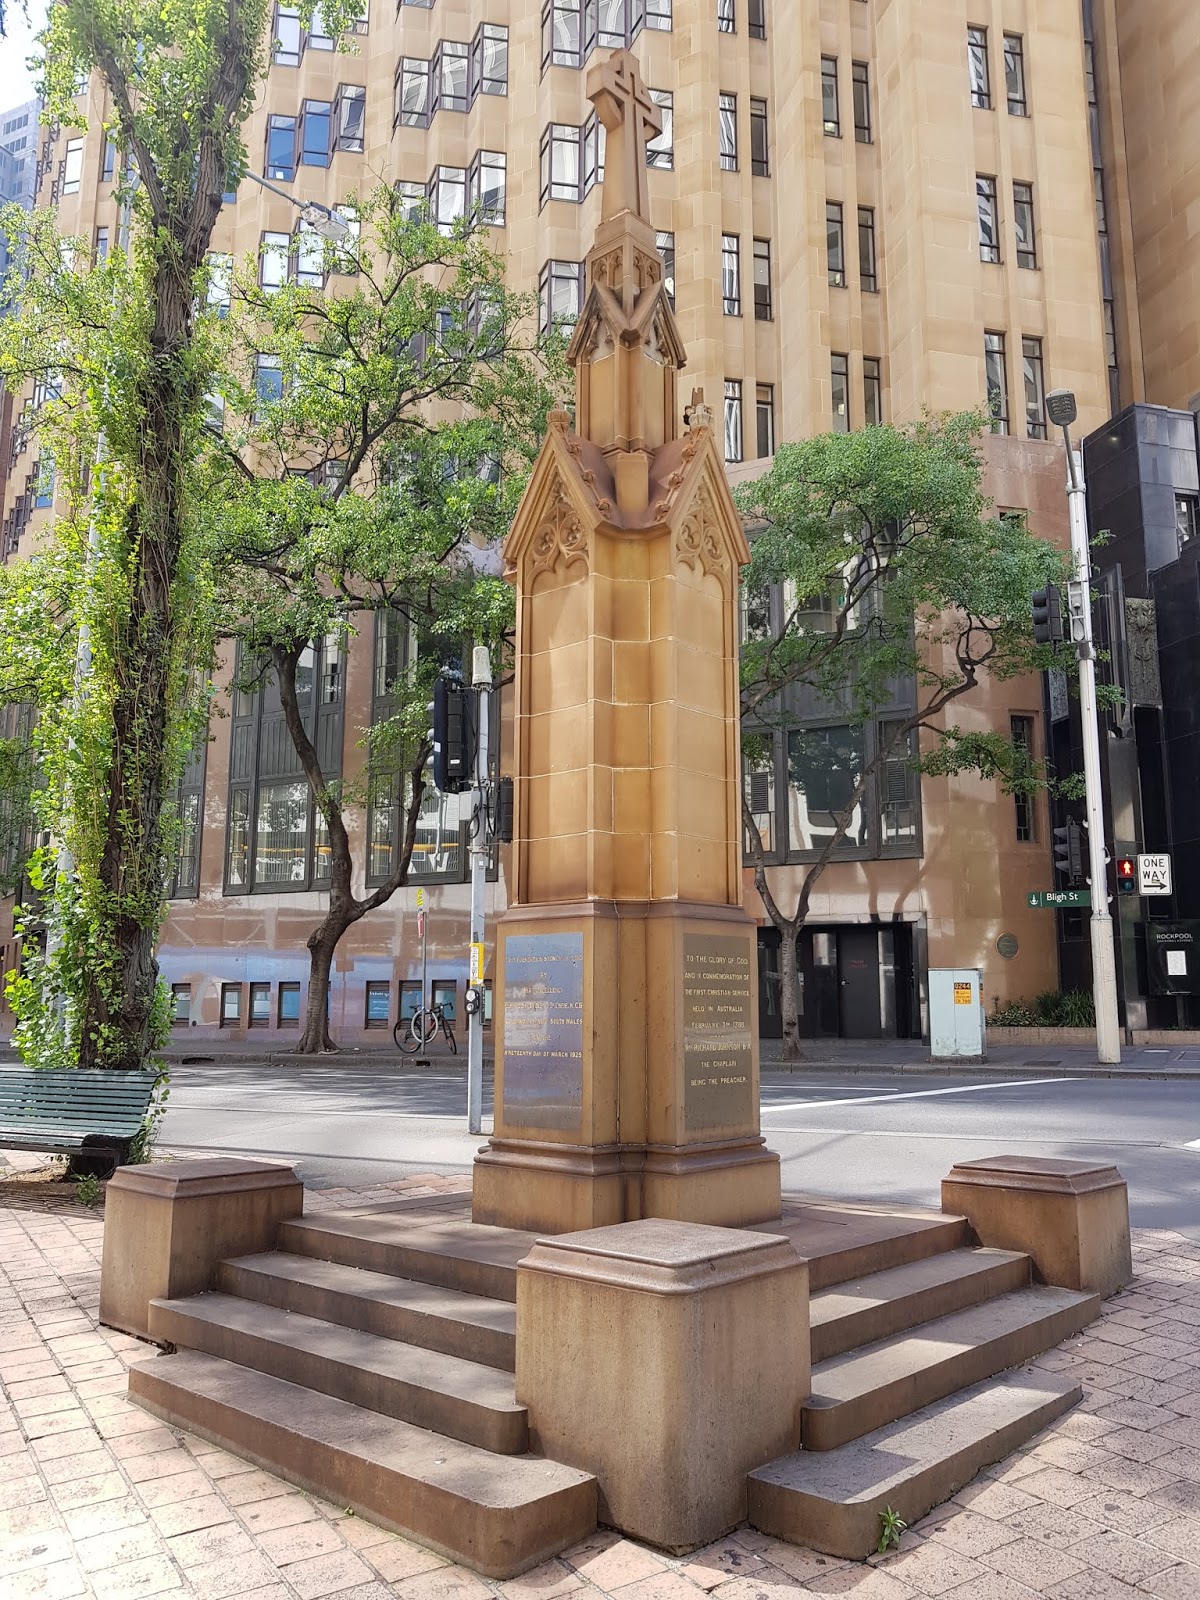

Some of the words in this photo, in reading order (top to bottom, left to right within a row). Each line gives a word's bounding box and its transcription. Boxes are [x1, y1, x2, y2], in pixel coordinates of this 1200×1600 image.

[1143, 858, 1165, 868] ONE
[1142, 870, 1167, 880] WAY
[1046, 892, 1067, 903] Bligh
[1068, 892, 1079, 901] St
[709, 956, 727, 964] GLORY
